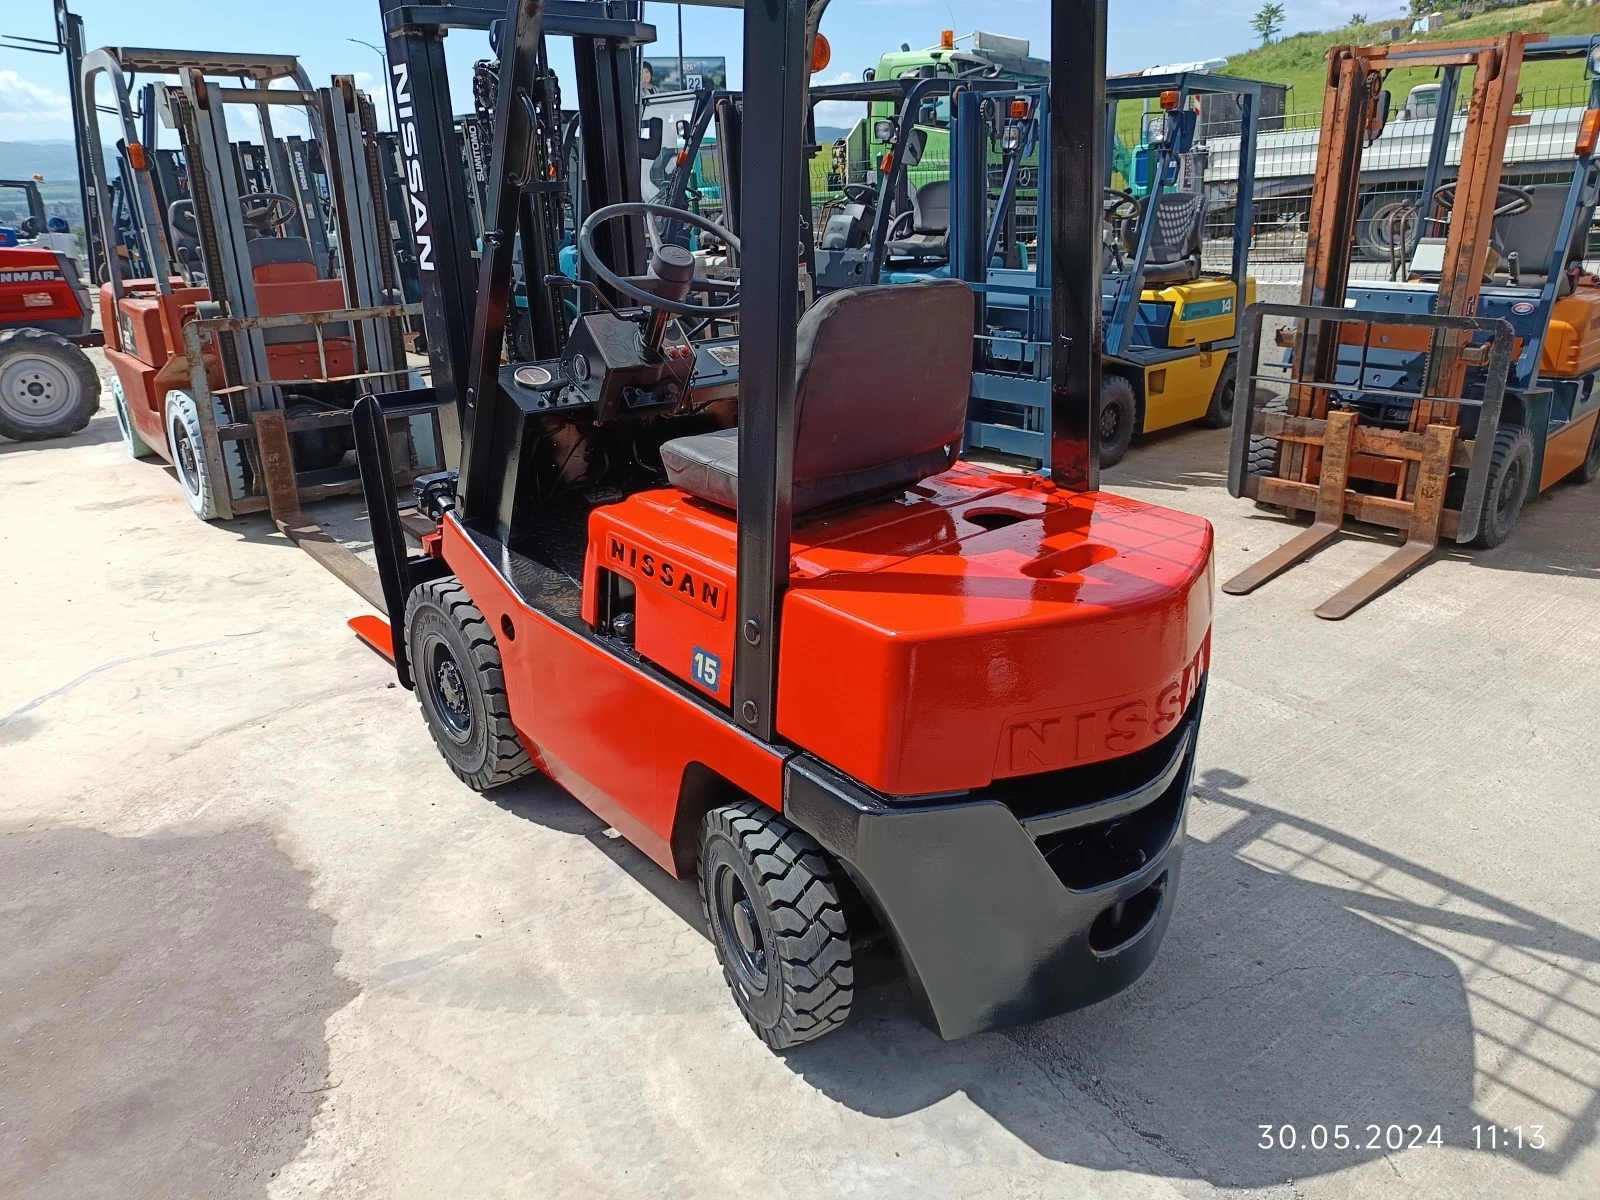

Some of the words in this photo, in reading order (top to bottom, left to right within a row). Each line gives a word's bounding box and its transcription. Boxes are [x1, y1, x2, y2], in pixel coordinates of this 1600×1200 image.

[688, 78, 700, 90] 22
[393, 63, 435, 271] NISSAN
[469, 125, 485, 182] SUMITOMO
[1222, 299, 1231, 312] 14
[611, 538, 719, 609] NISSAN
[694, 652, 717, 685] 15
